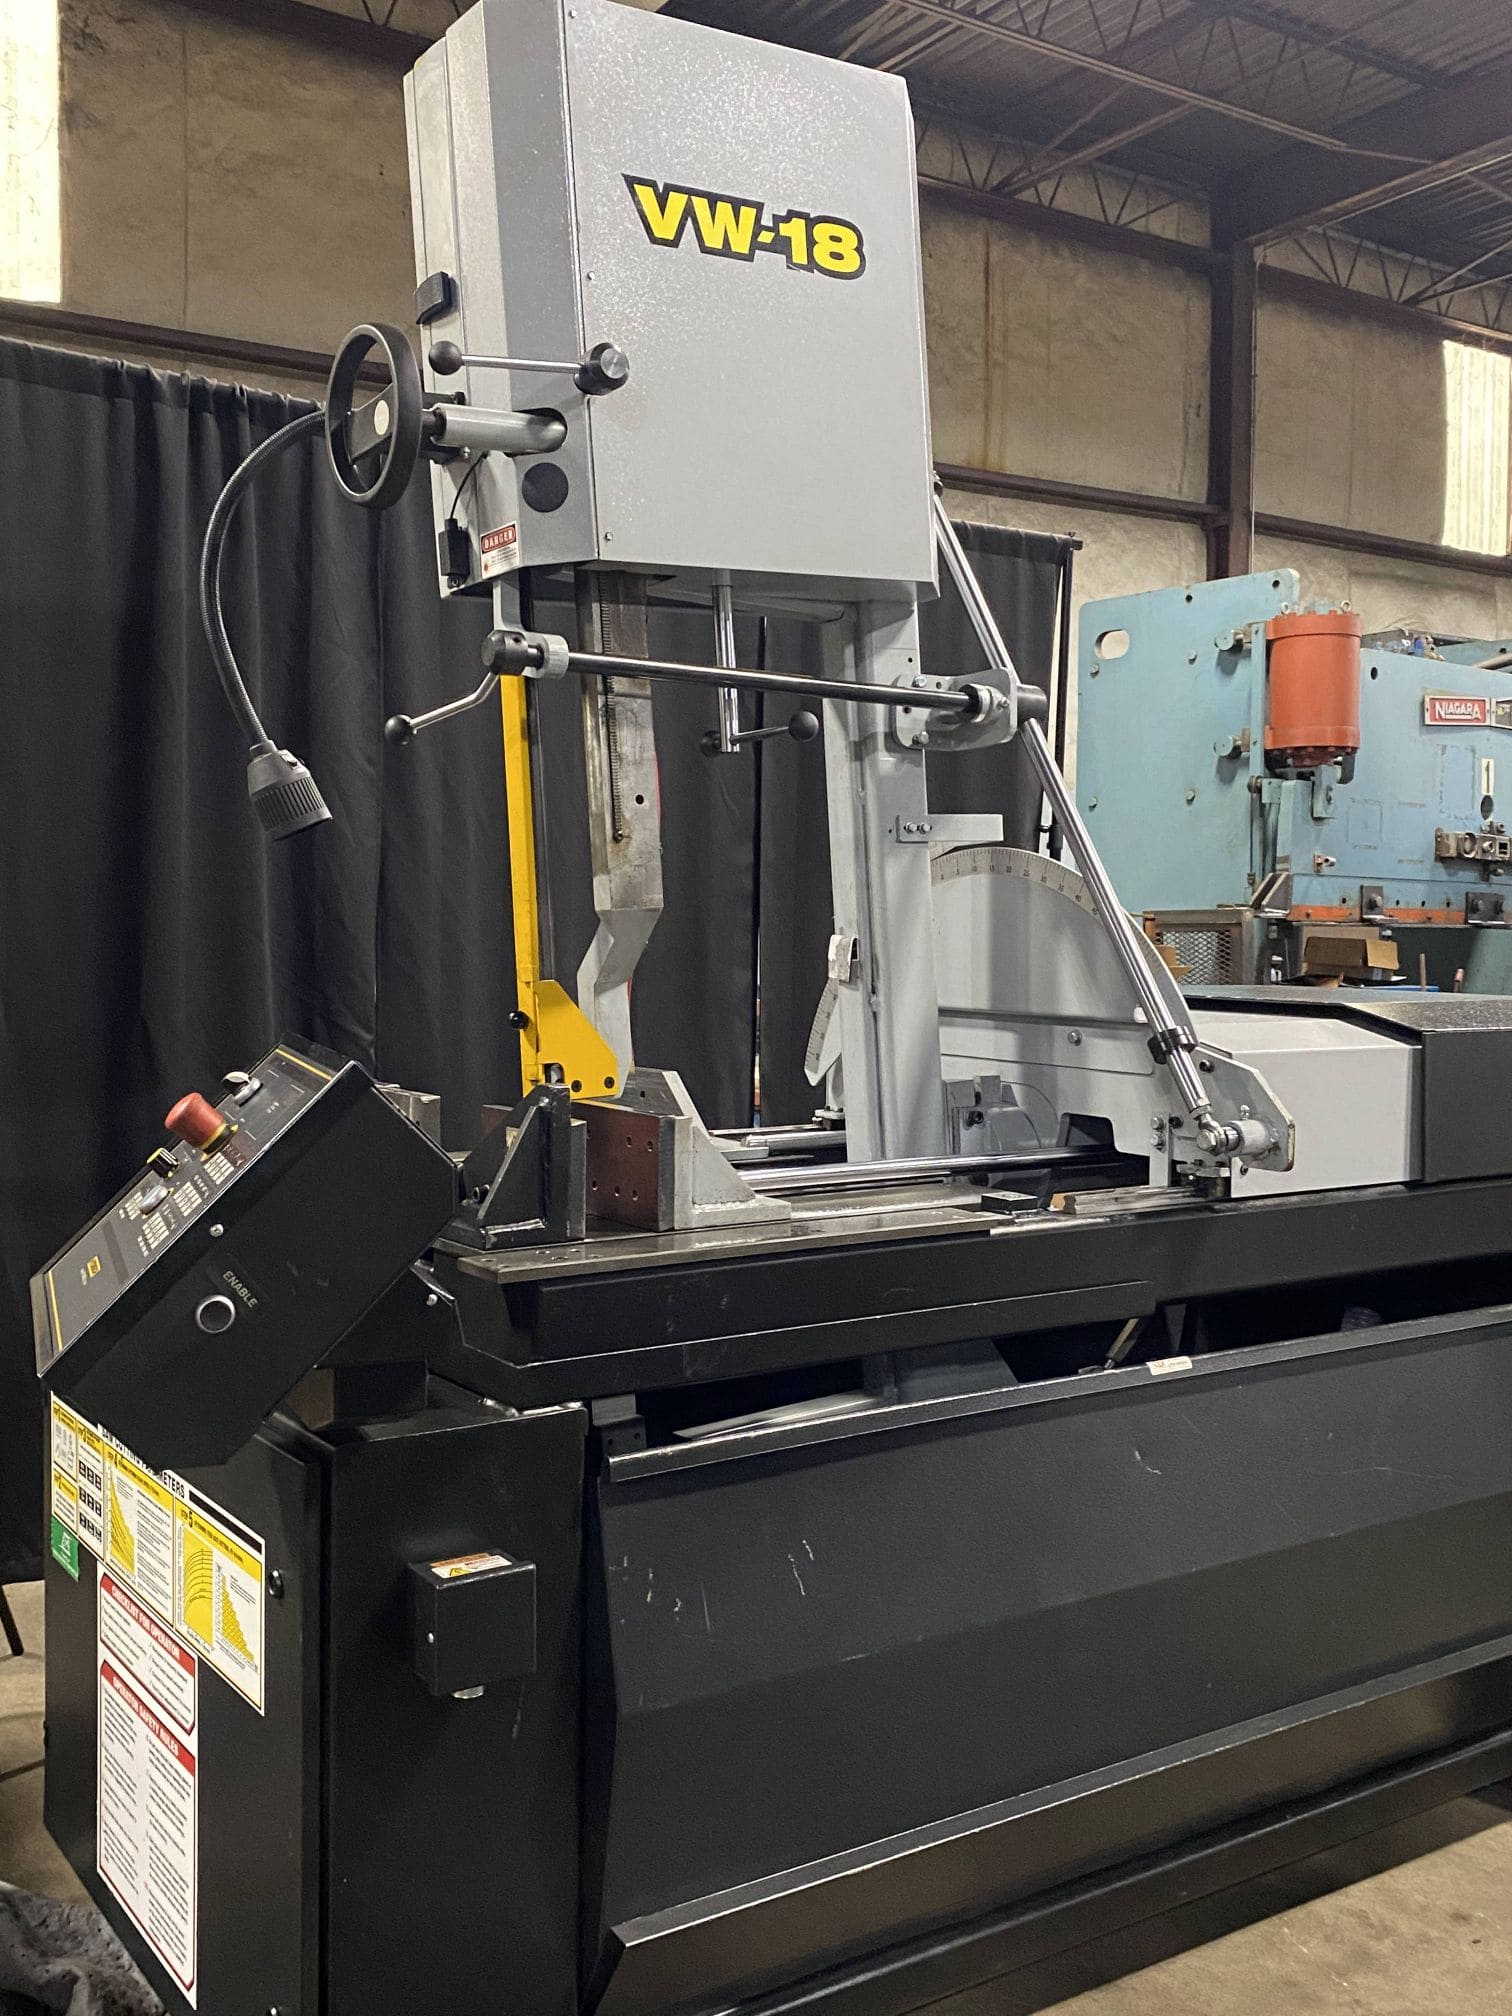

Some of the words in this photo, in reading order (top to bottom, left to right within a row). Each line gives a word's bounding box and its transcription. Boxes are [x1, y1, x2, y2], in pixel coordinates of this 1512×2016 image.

[627, 179, 864, 276] VW-18
[484, 529, 513, 549] DANGER
[1435, 702, 1482, 720] NIAGARA
[222, 1270, 258, 1308] ENABLE
[112, 1585, 139, 1620] CHECKLIST
[151, 1623, 180, 1661] OPERATOR
[112, 1677, 139, 1716] OPERATOR
[139, 1704, 160, 1738] SAFETY
[160, 1725, 179, 1757] RULES
